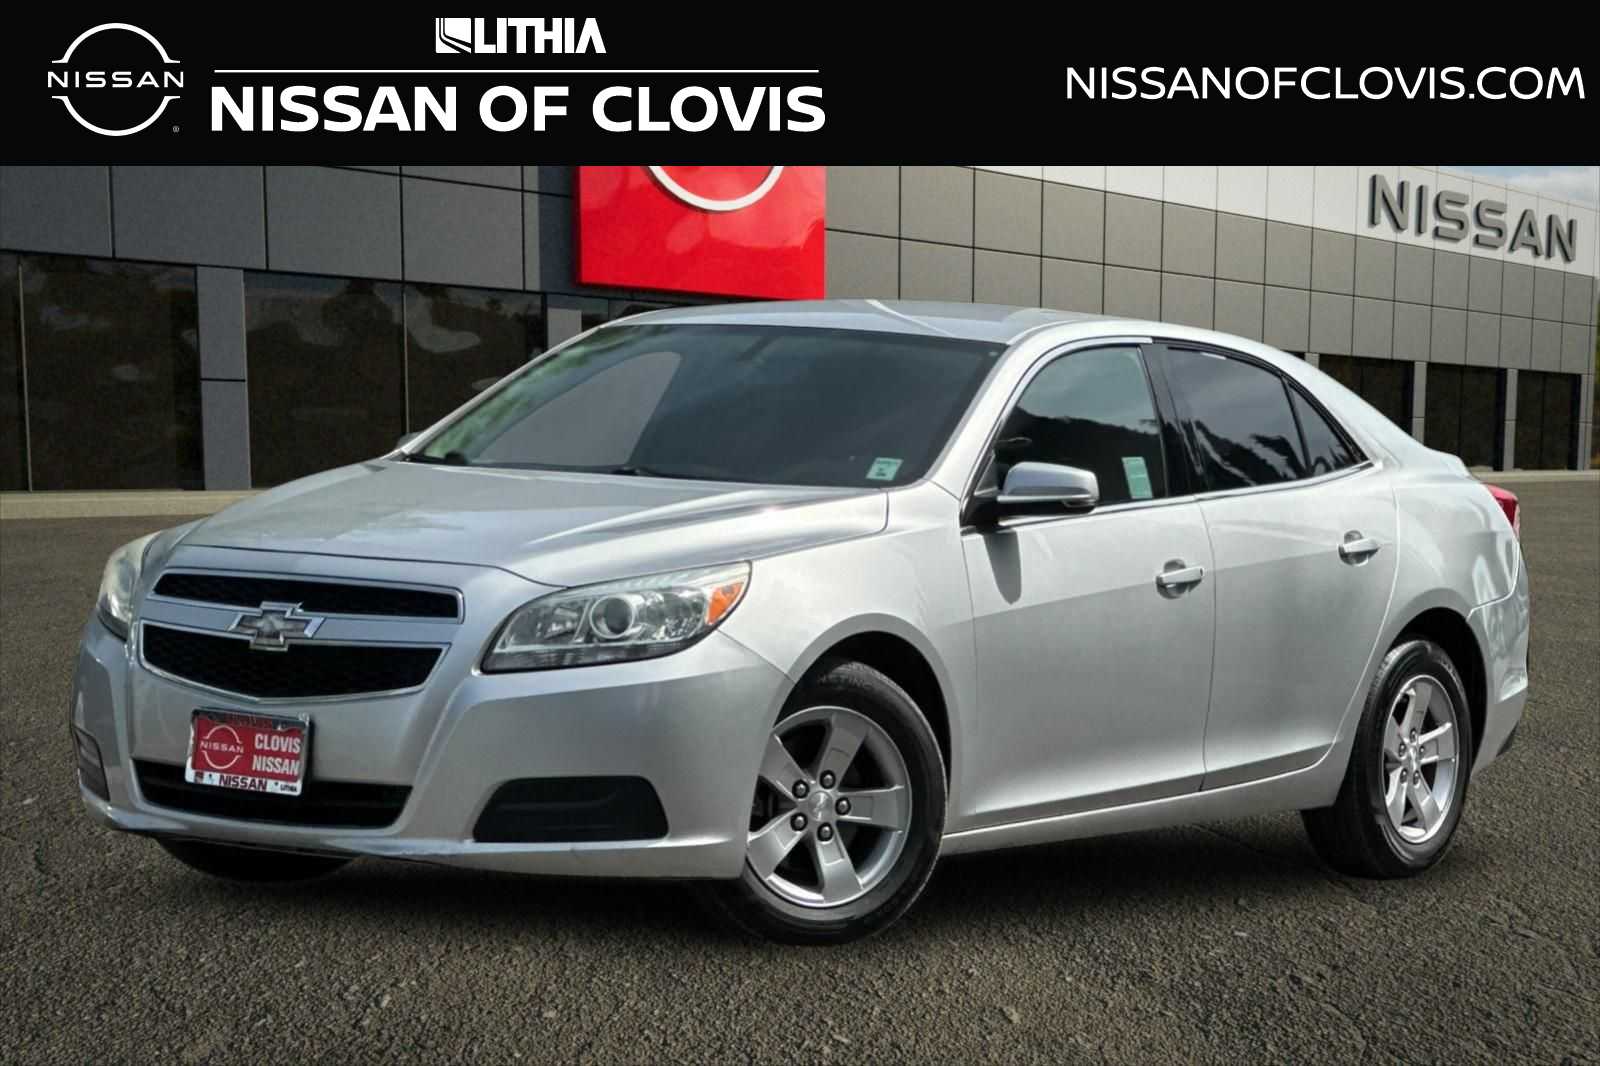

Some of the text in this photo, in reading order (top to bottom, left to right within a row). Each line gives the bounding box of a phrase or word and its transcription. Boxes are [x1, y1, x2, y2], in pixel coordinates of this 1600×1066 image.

[1368, 173, 1577, 263] NISSAN
[200, 740, 244, 753] NISSAN
[254, 733, 301, 754] CLOVIS
[251, 754, 300, 776] NISSAN
[219, 774, 268, 792] NISSAN
